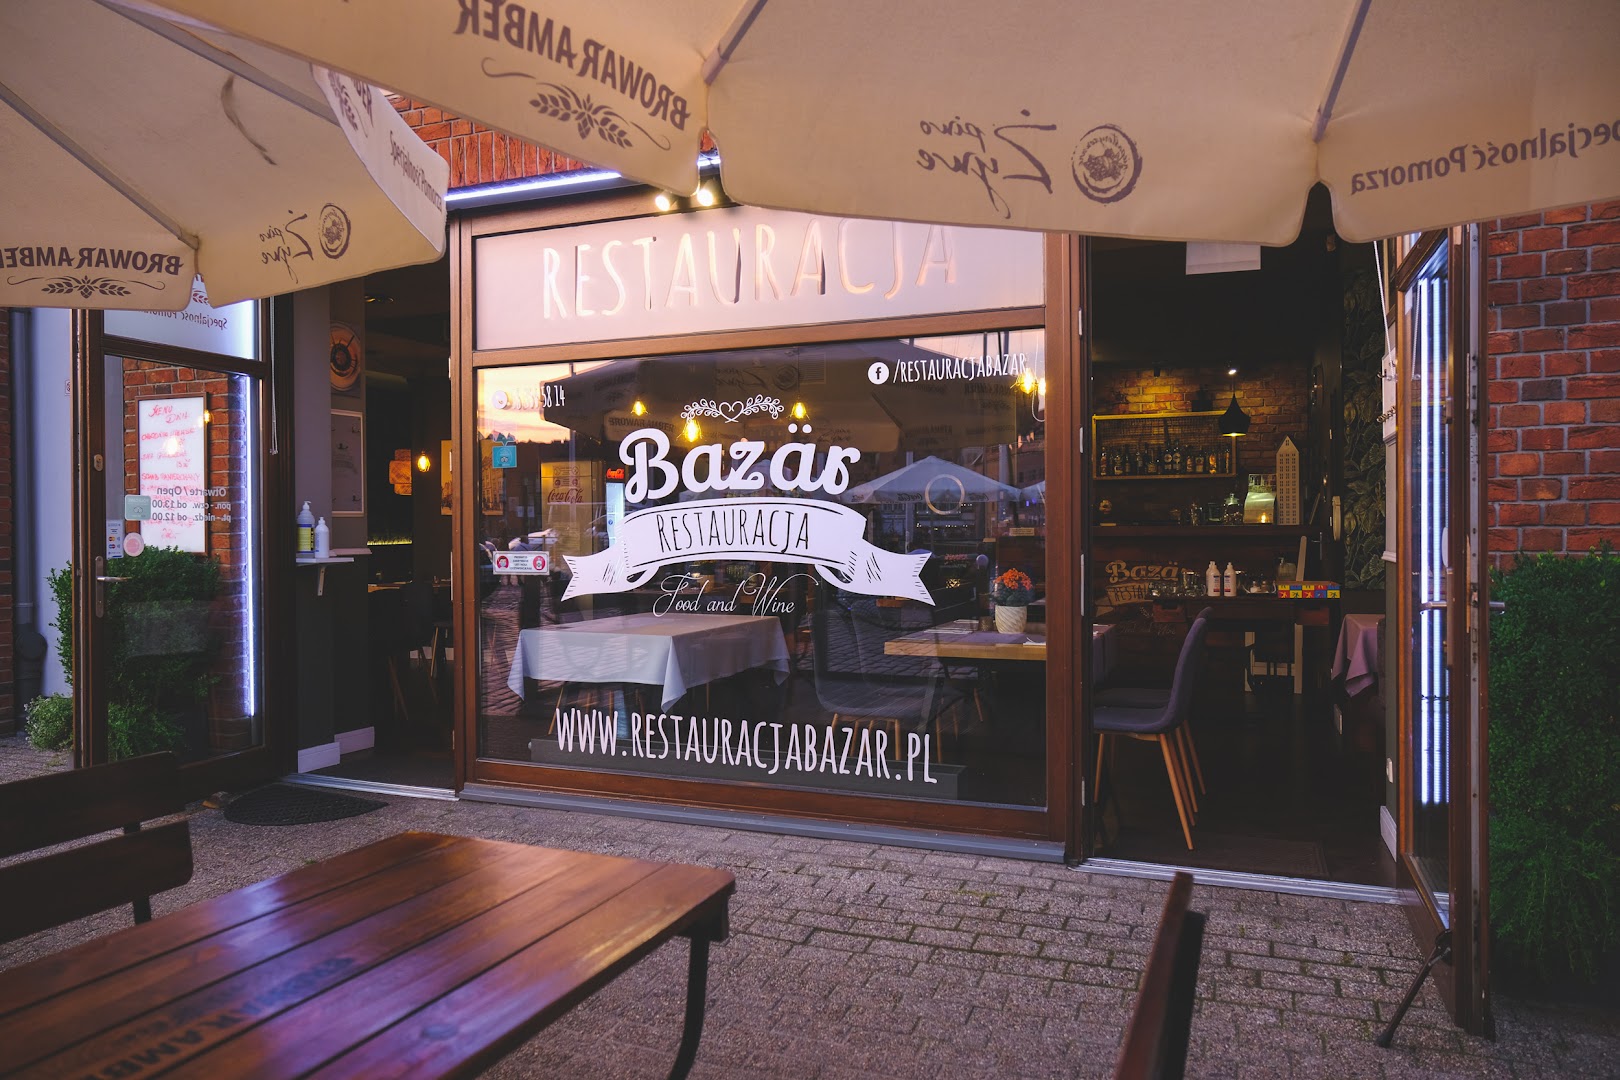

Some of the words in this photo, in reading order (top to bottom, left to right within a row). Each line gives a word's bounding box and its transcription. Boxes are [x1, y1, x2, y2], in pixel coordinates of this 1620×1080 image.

[542, 217, 957, 321] RESTAURACJA
[656, 508, 809, 554] RESTAURACJA
[1105, 560, 1188, 583] Bazä
[653, 572, 710, 617] Food
[706, 579, 746, 612] and
[742, 572, 819, 618] Wine
[555, 707, 938, 784] WWW.RESTAURACJABAZAR.PL
